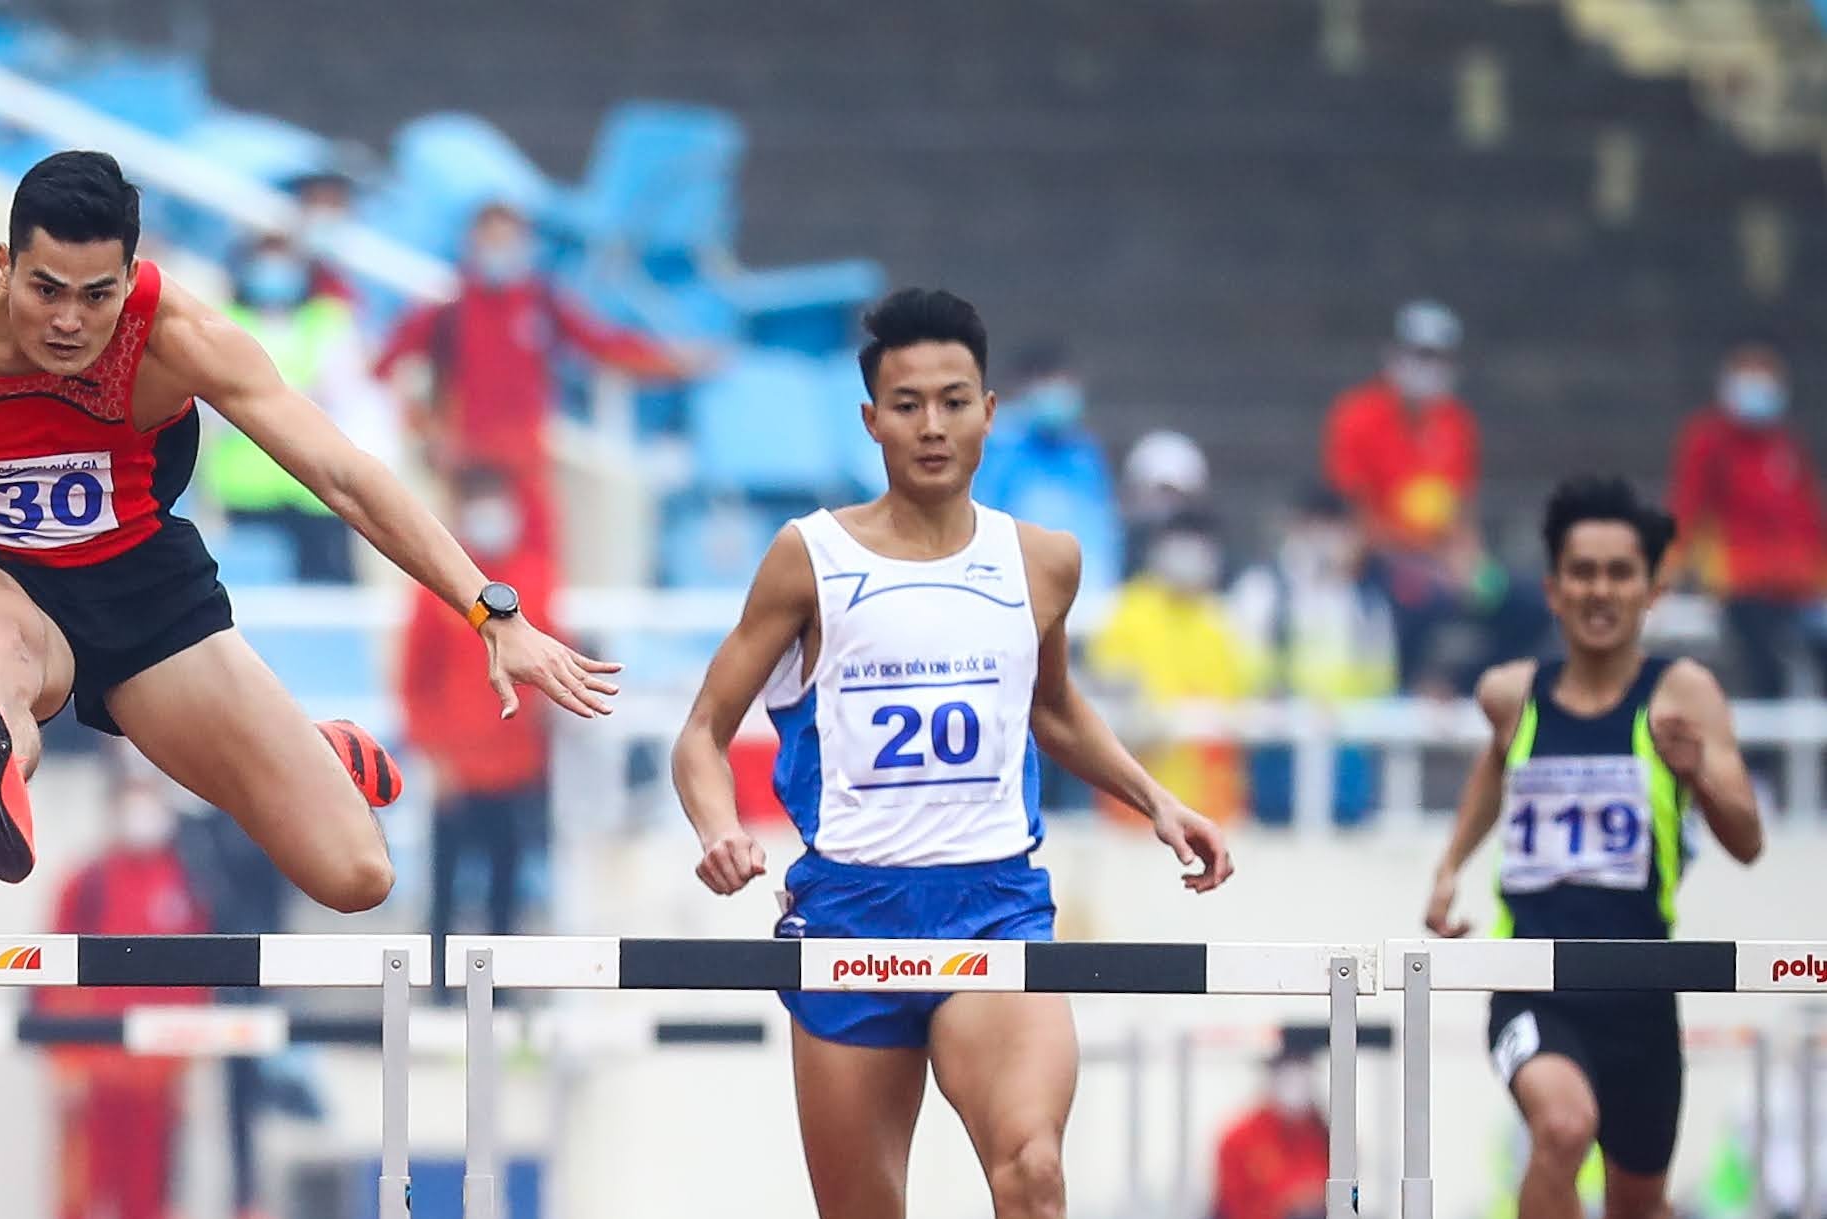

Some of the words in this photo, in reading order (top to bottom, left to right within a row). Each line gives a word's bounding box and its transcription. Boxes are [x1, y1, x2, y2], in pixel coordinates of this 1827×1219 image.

[871, 701, 981, 770] 20
[1510, 799, 1640, 856] 119
[832, 954, 933, 983] polytan
